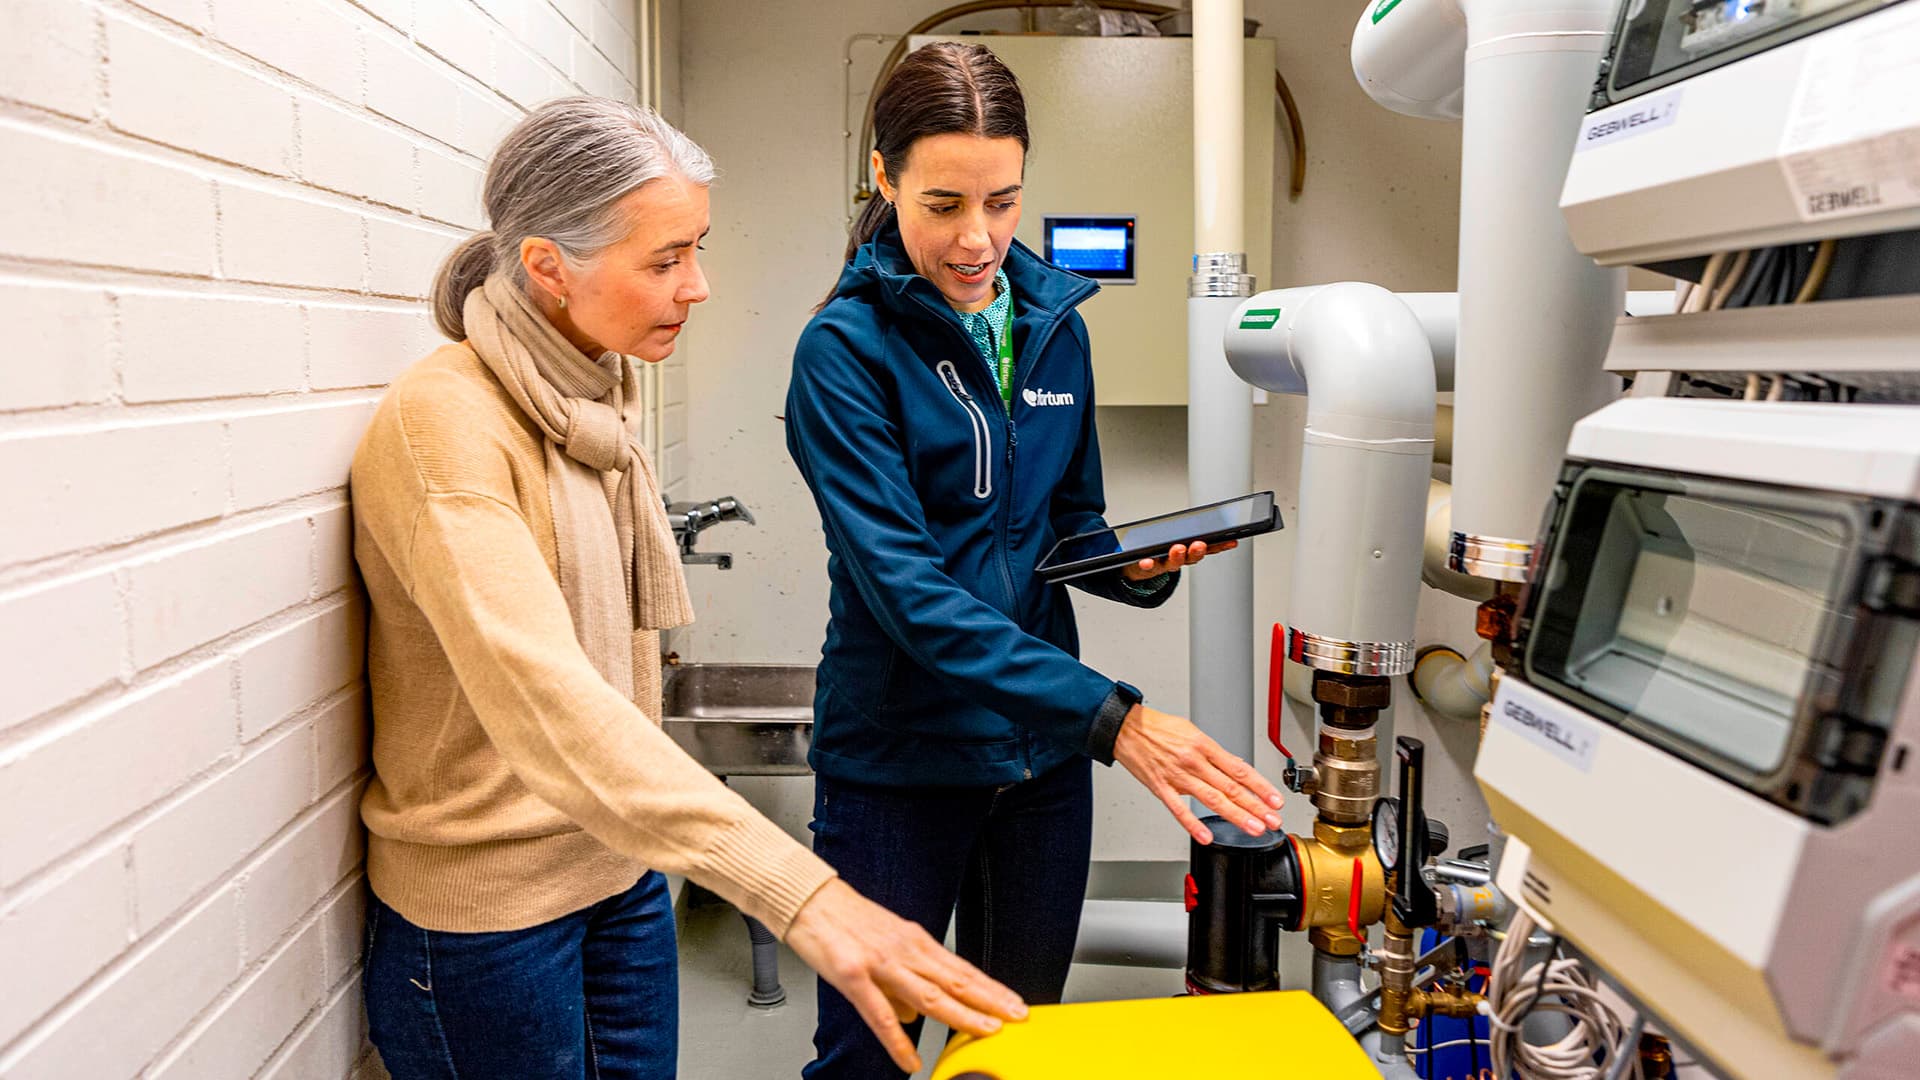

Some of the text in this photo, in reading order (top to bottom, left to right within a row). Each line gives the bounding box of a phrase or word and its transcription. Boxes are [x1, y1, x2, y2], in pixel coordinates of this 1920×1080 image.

[1587, 107, 1660, 141] GEBWELL
[1002, 363, 1010, 389] fortum
[1036, 388, 1075, 406] fortum
[1505, 700, 1576, 751] GEBWELL
